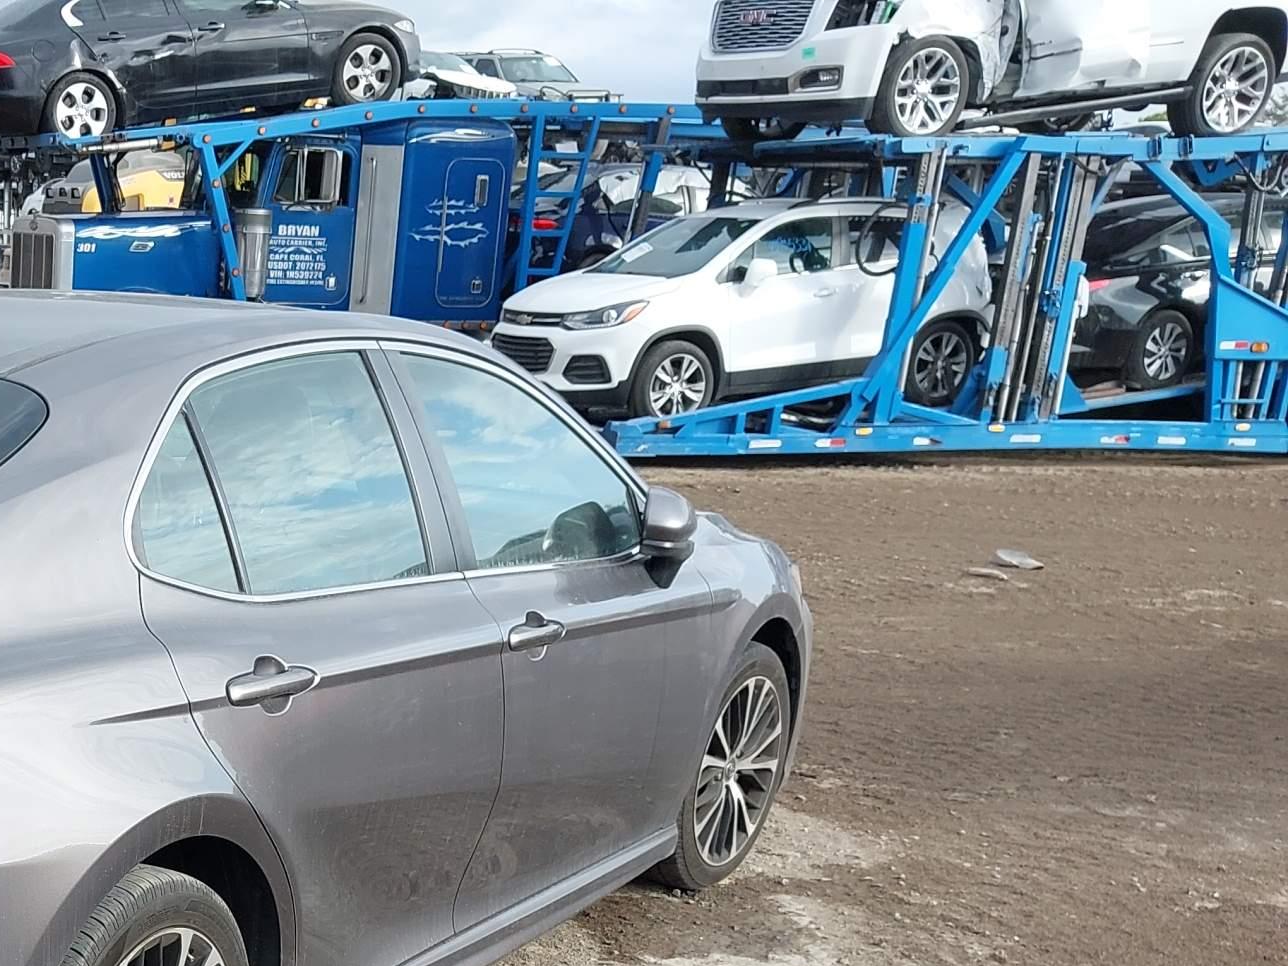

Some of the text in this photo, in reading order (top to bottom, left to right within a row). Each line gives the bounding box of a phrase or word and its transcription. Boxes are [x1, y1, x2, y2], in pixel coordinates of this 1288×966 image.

[162, 171, 185, 179] VOL
[278, 224, 320, 237] BRYAN
[269, 239, 286, 247] AUTO
[76, 242, 96, 253] 301
[269, 253, 289, 261] CAPE
